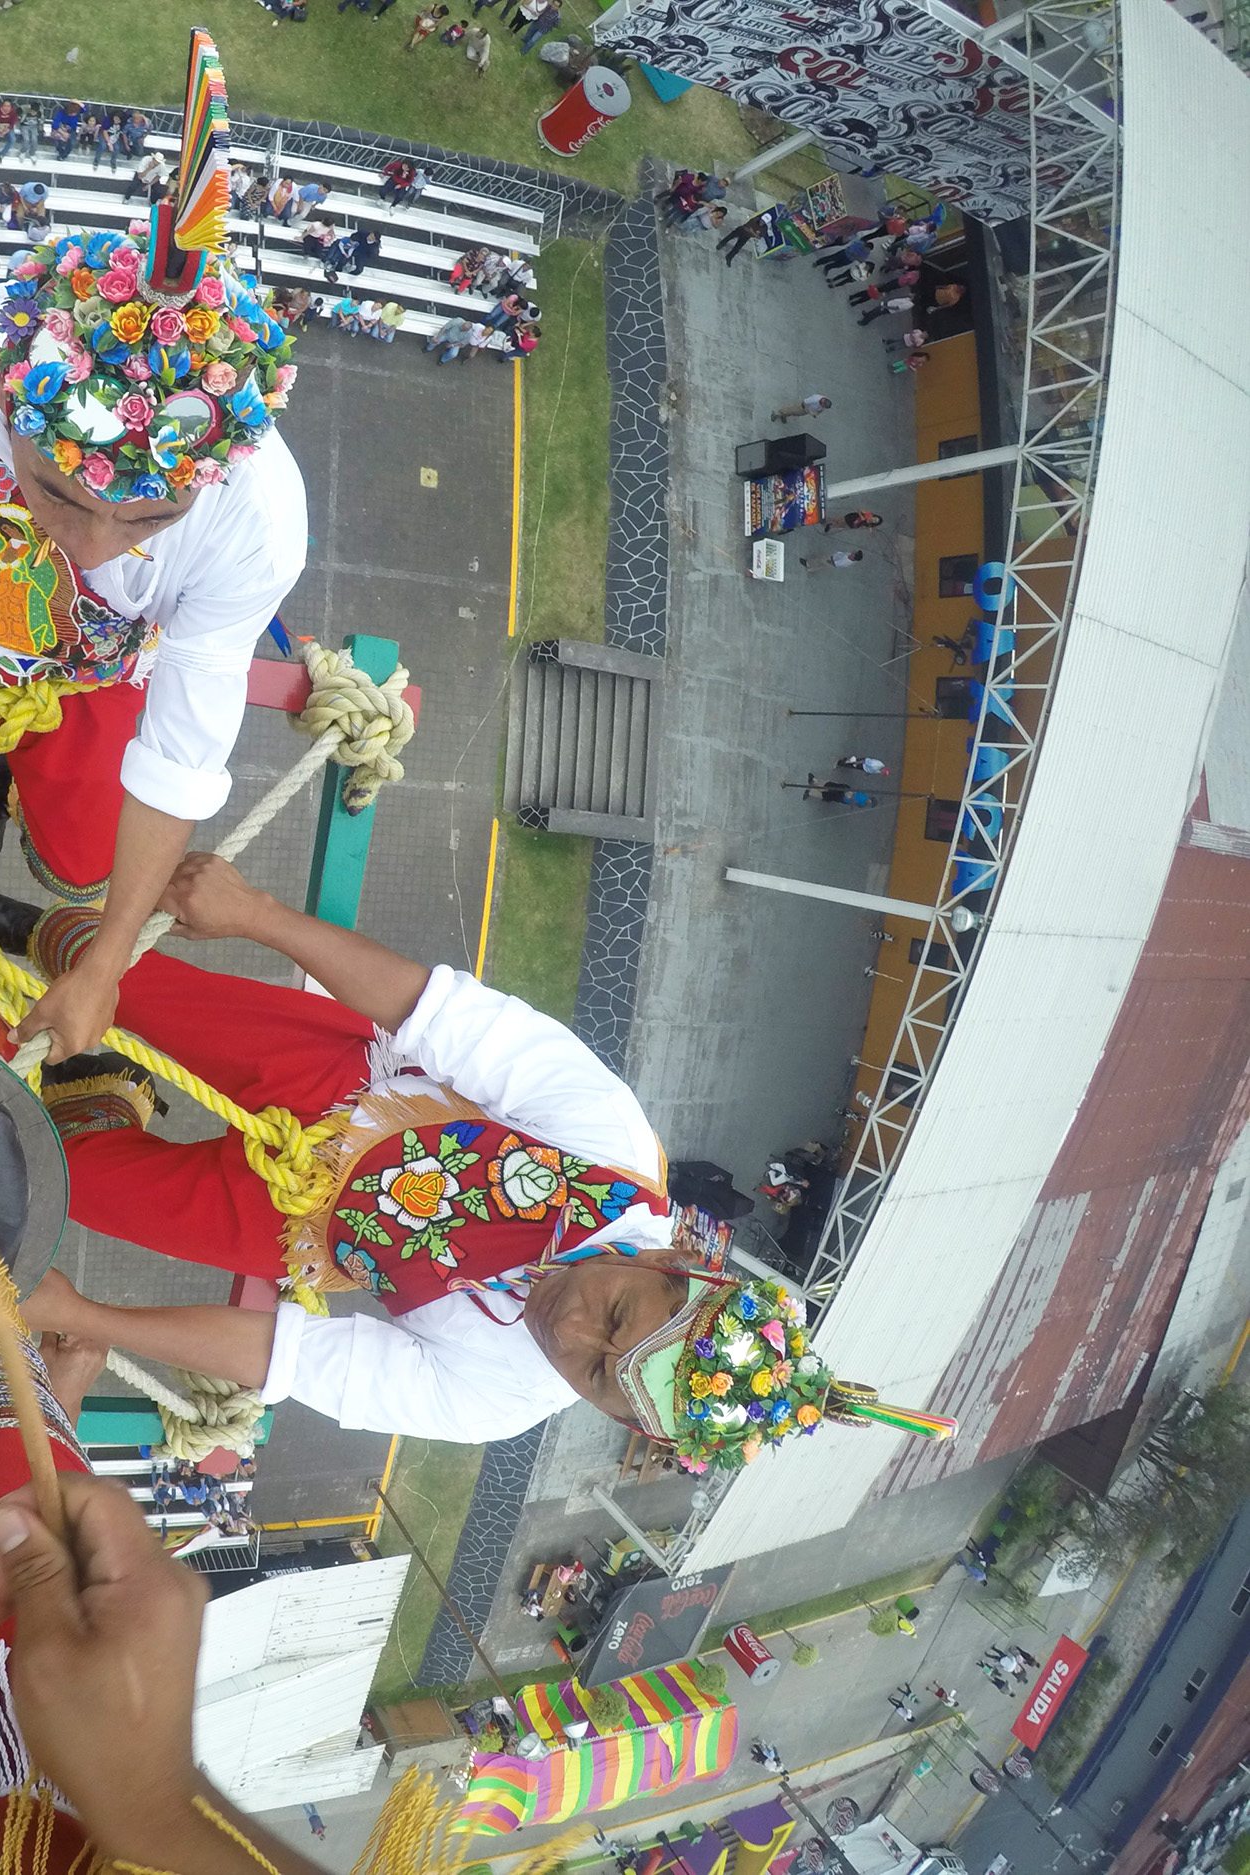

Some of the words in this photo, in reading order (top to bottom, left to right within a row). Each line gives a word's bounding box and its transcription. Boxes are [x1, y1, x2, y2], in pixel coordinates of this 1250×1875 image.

[736, 18, 797, 38] CERVEZA
[777, 46, 868, 90] SOL
[671, 1573, 703, 1592] zero
[608, 1620, 628, 1650] zero
[1026, 1659, 1069, 1725] SALIDA
